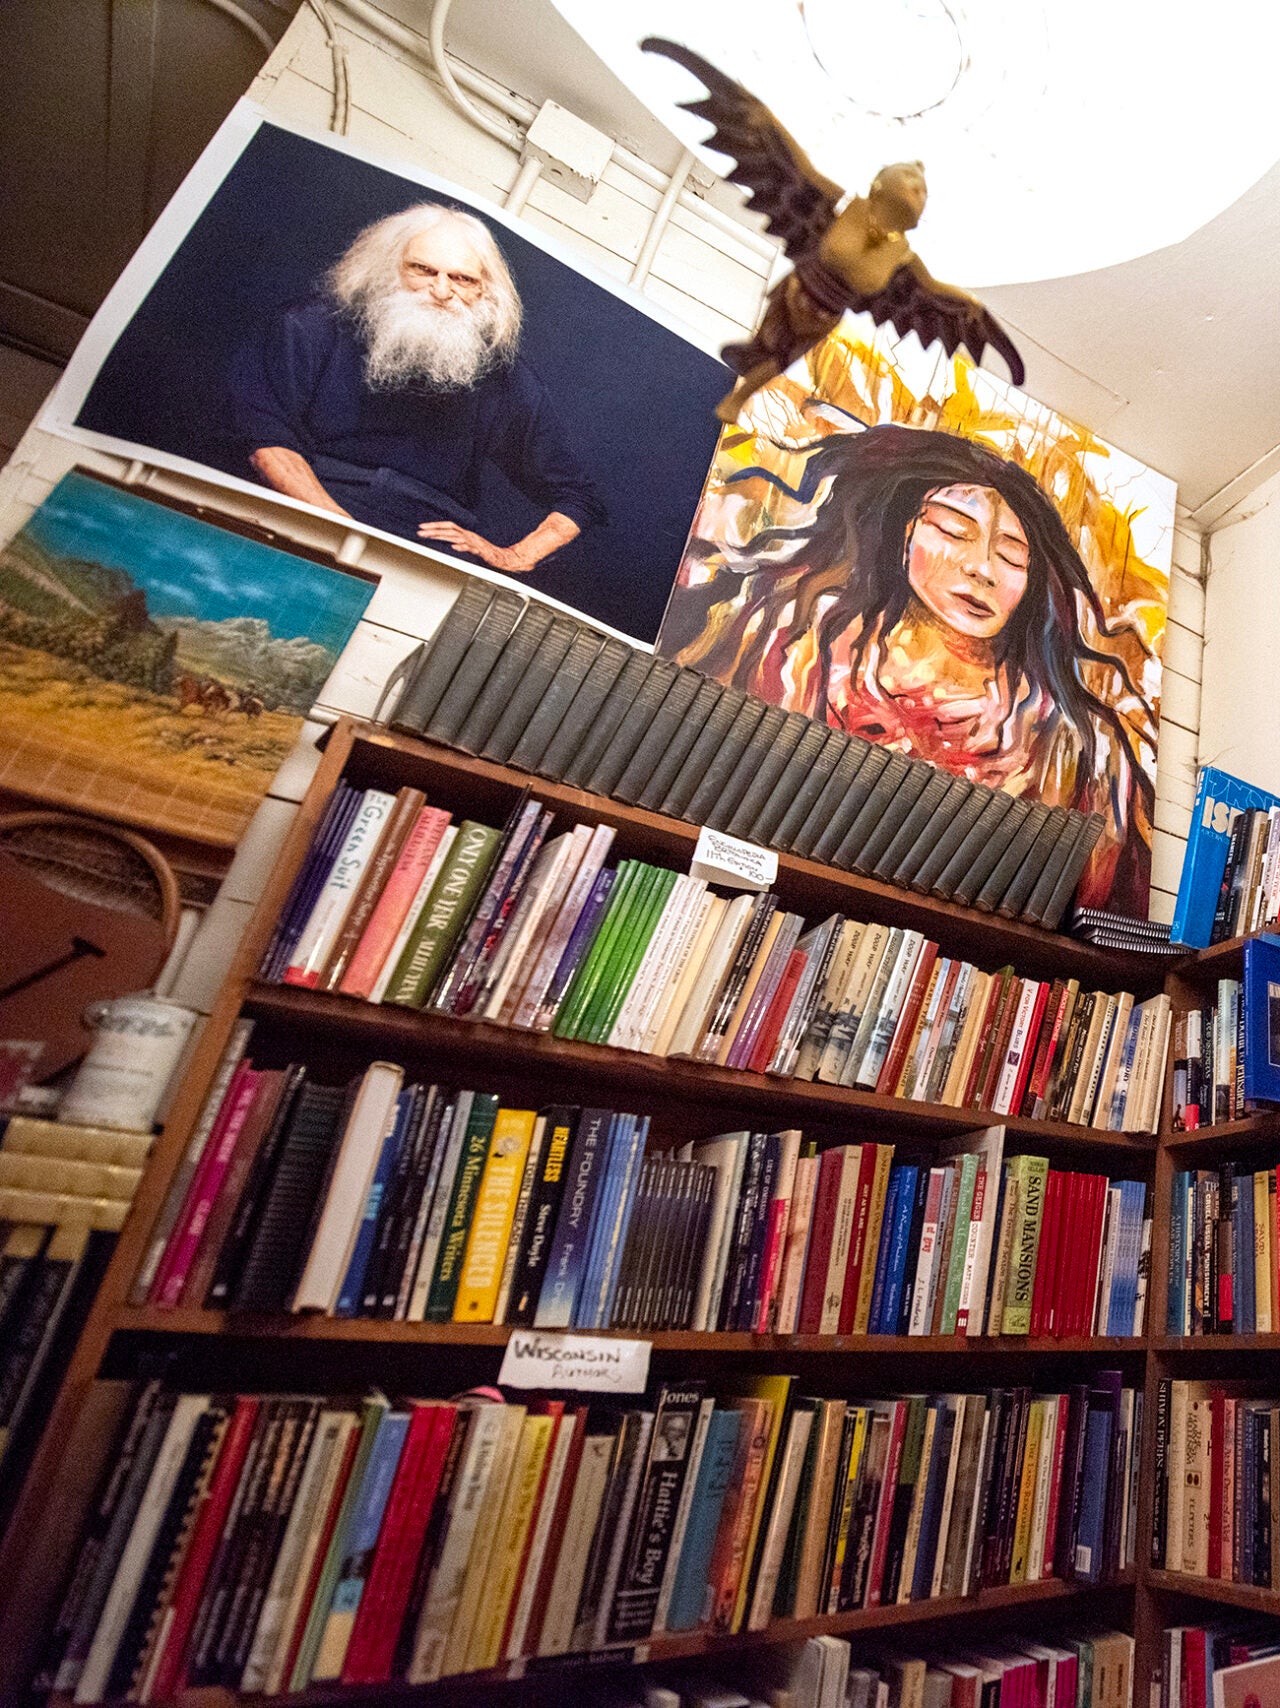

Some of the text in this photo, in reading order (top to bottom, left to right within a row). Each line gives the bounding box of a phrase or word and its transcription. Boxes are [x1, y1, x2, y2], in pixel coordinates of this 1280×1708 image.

[329, 801, 384, 893] Green Suit
[426, 824, 488, 934] ONLY ONE YEAR
[843, 930, 860, 966] DOOR WAY
[864, 932, 881, 969] DOOR WAY
[899, 939, 916, 974] DOOR WAY
[1017, 1005, 1028, 1028] VICTORY
[1012, 1029, 1022, 1049] BLUES
[542, 1124, 570, 1184] HEARTLESS
[566, 1117, 600, 1228] THE FOUNDRY
[438, 1135, 486, 1283] 26 Minnesota Writers
[972, 1176, 984, 1219] THE GEIGER
[1006, 1202, 1015, 1216] The
[464, 1159, 517, 1292] THE SILENCED
[524, 1203, 552, 1268] Steve Doyle
[967, 1223, 977, 1258] COUNTER
[1014, 1175, 1041, 1301] SAND MANSIONS
[995, 1279, 1005, 1301] Jones
[660, 1388, 699, 1404] Jones
[1027, 1441, 1036, 1460] THE
[638, 1469, 679, 1585] Hattie's Boy
